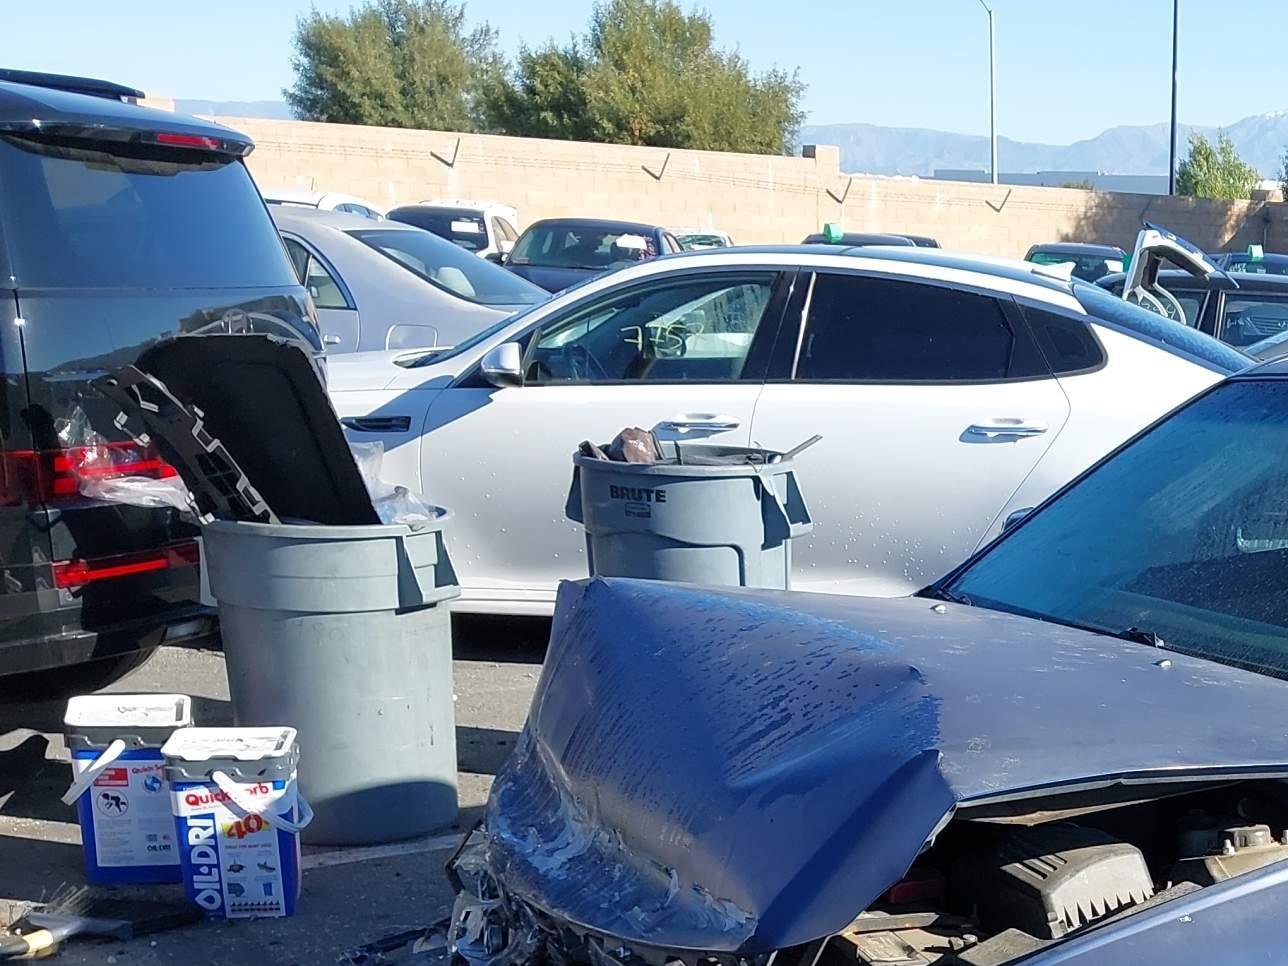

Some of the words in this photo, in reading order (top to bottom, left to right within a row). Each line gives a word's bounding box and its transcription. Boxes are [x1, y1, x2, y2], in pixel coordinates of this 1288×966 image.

[610, 485, 667, 503] BRUTE
[185, 789, 231, 807] Quick
[226, 813, 263, 839] 40
